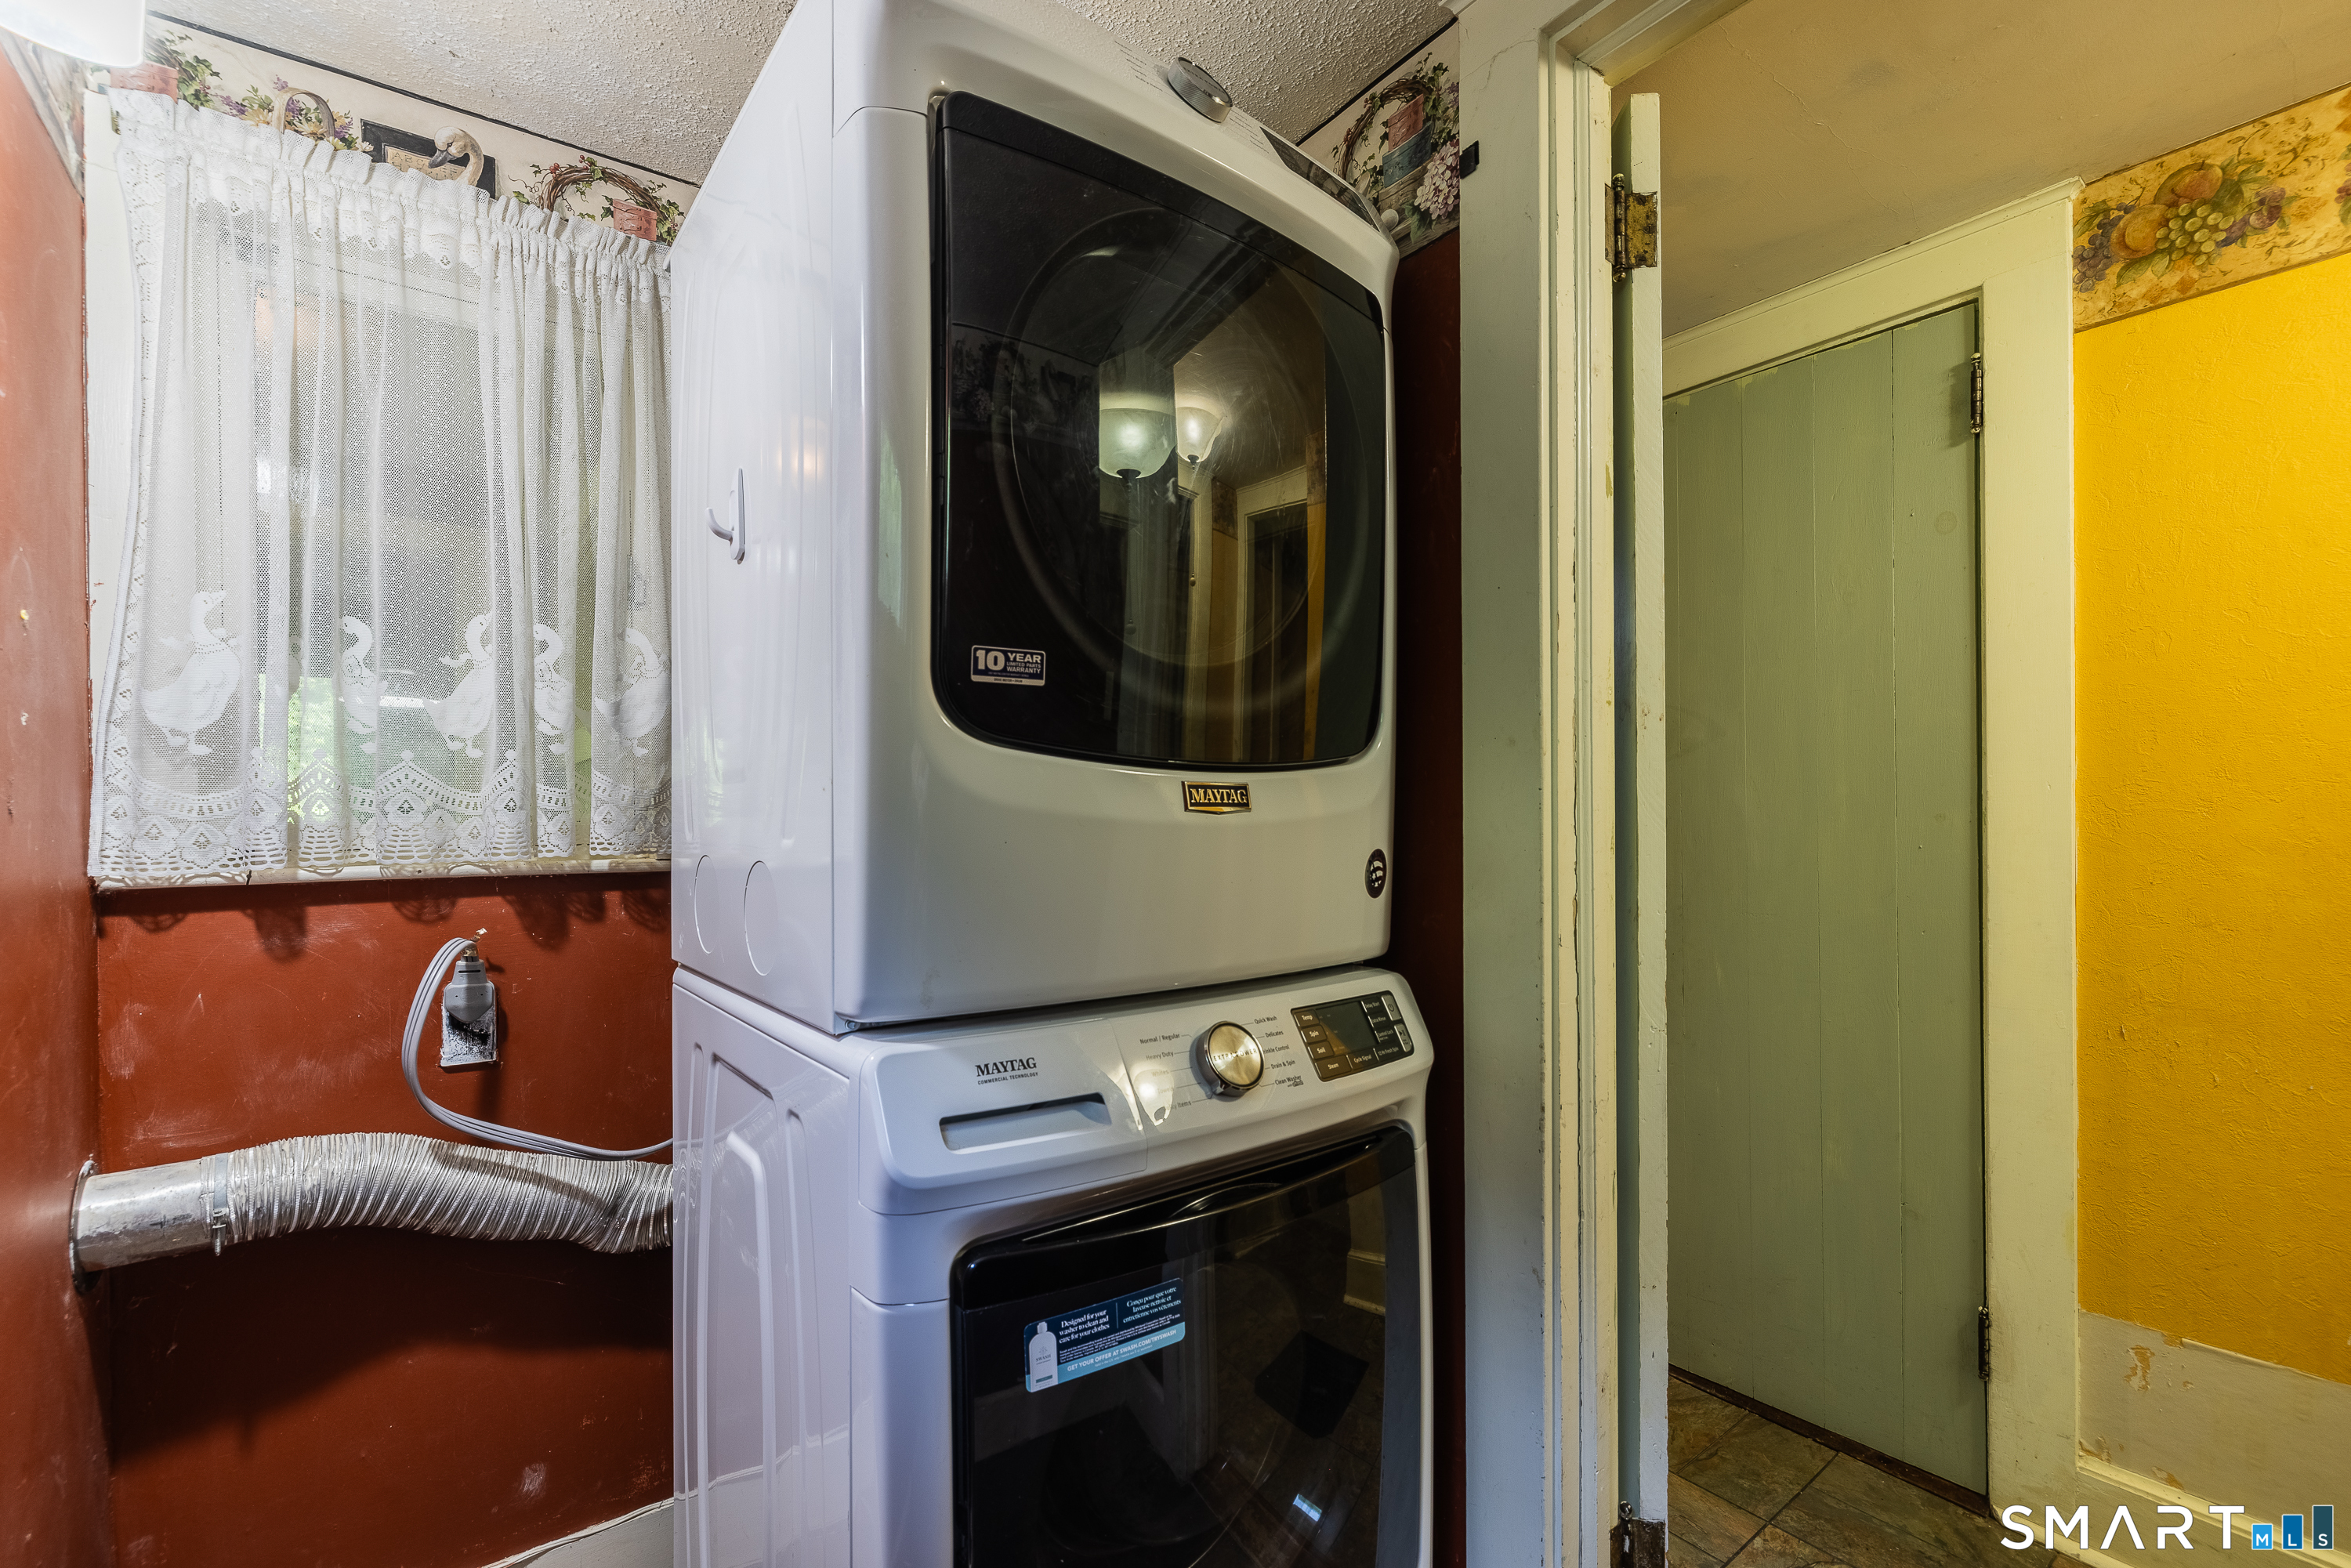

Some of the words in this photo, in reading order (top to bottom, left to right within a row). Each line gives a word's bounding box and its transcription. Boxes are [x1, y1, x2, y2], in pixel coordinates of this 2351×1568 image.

[976, 650, 1005, 671] 10
[1007, 652, 1041, 663] YEAR
[1190, 788, 1248, 803] MAYTAG
[1139, 1036, 1158, 1045] Normal
[1161, 1033, 1180, 1041] Regular
[1265, 1030, 1284, 1038] Delicates
[1213, 1052, 1234, 1062] EXTRA
[1234, 1048, 1259, 1058] POWER
[1275, 1044, 1290, 1052] Control
[975, 1057, 1037, 1077] MAYTAG
[1059, 1324, 1078, 1336] washer
[1085, 1319, 1099, 1328] clean
[1099, 1315, 1109, 1324] and
[1060, 1315, 1086, 1328] Designed
[1093, 1309, 1107, 1320] your
[1059, 1334, 1070, 1344] care
[1078, 1328, 1092, 1339] your
[1091, 1323, 1110, 1334] clothes
[1035, 1353, 1052, 1363] SWASH
[1067, 1363, 1078, 1372] GET
[1078, 1358, 1095, 1369] YOUR
[1094, 1353, 1113, 1364] OFFER
[1119, 1329, 1177, 1354] SWASH.COM/TRYSWASH
